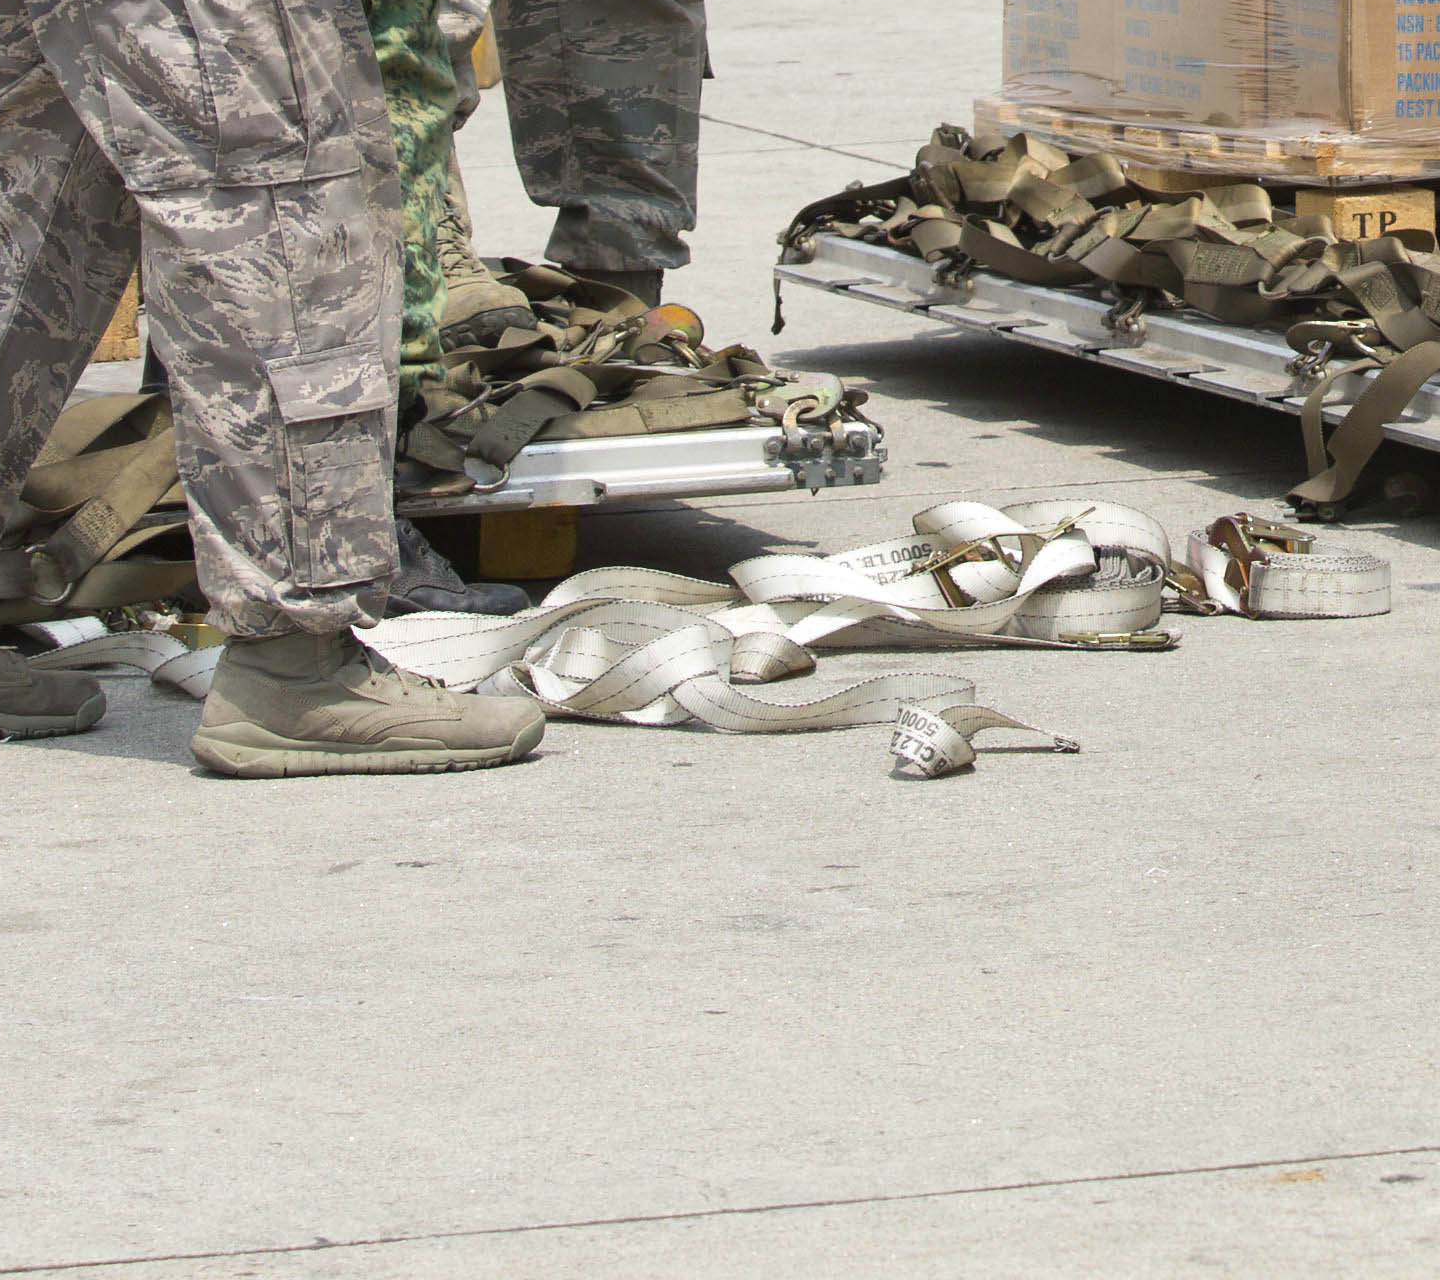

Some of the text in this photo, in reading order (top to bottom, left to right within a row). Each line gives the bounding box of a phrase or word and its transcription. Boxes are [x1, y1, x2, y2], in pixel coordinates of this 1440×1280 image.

[1396, 14, 1423, 34] NSN
[1396, 42, 1413, 61] 15
[1395, 99, 1433, 118] BEST
[1352, 210, 1397, 239] TP
[891, 543, 933, 564] 5000
